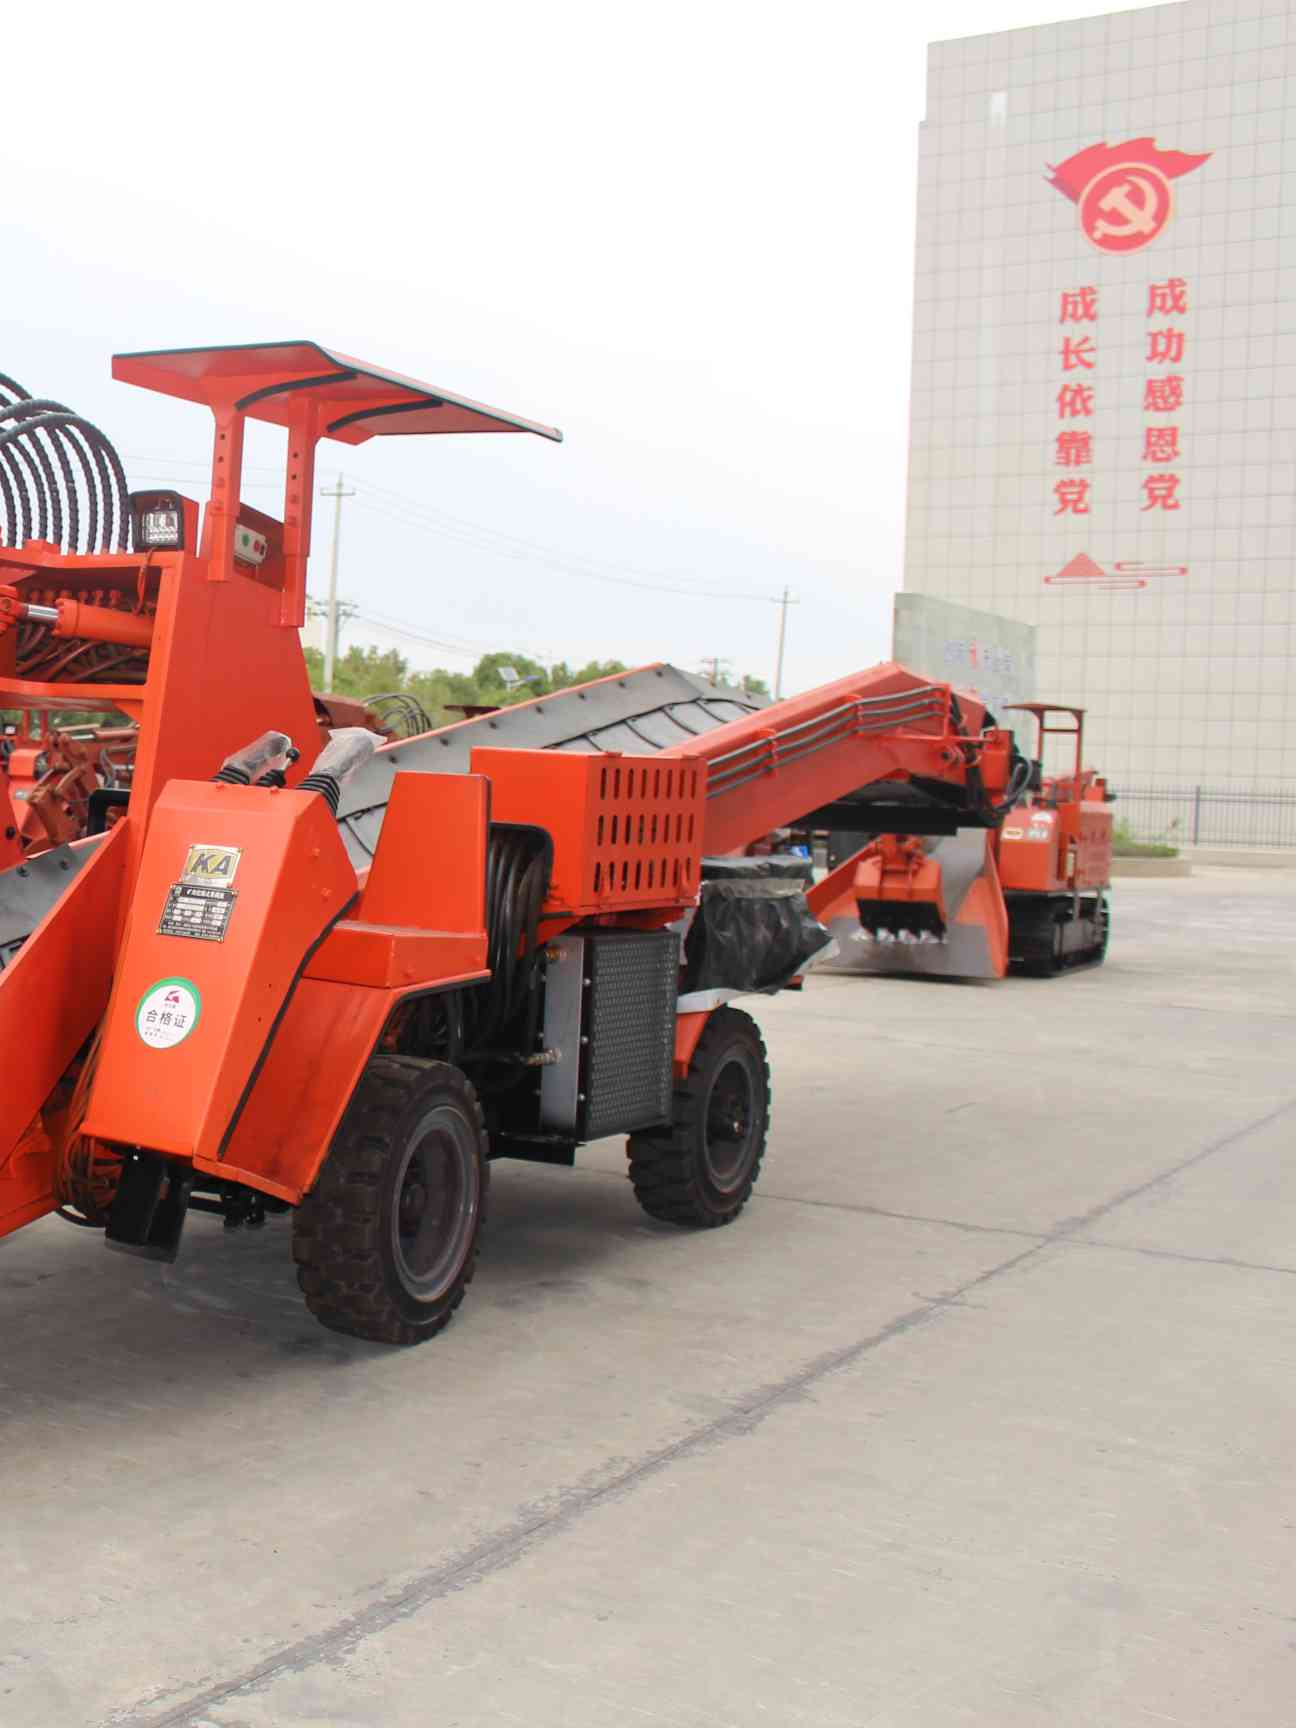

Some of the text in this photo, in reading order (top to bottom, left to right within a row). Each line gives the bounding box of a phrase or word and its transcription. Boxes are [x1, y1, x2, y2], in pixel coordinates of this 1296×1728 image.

[1054, 285, 1098, 516] 成长依靠党
[1139, 277, 1187, 512] 成功感恩党
[190, 853, 232, 876] KA
[146, 1009, 188, 1029] 合格证
